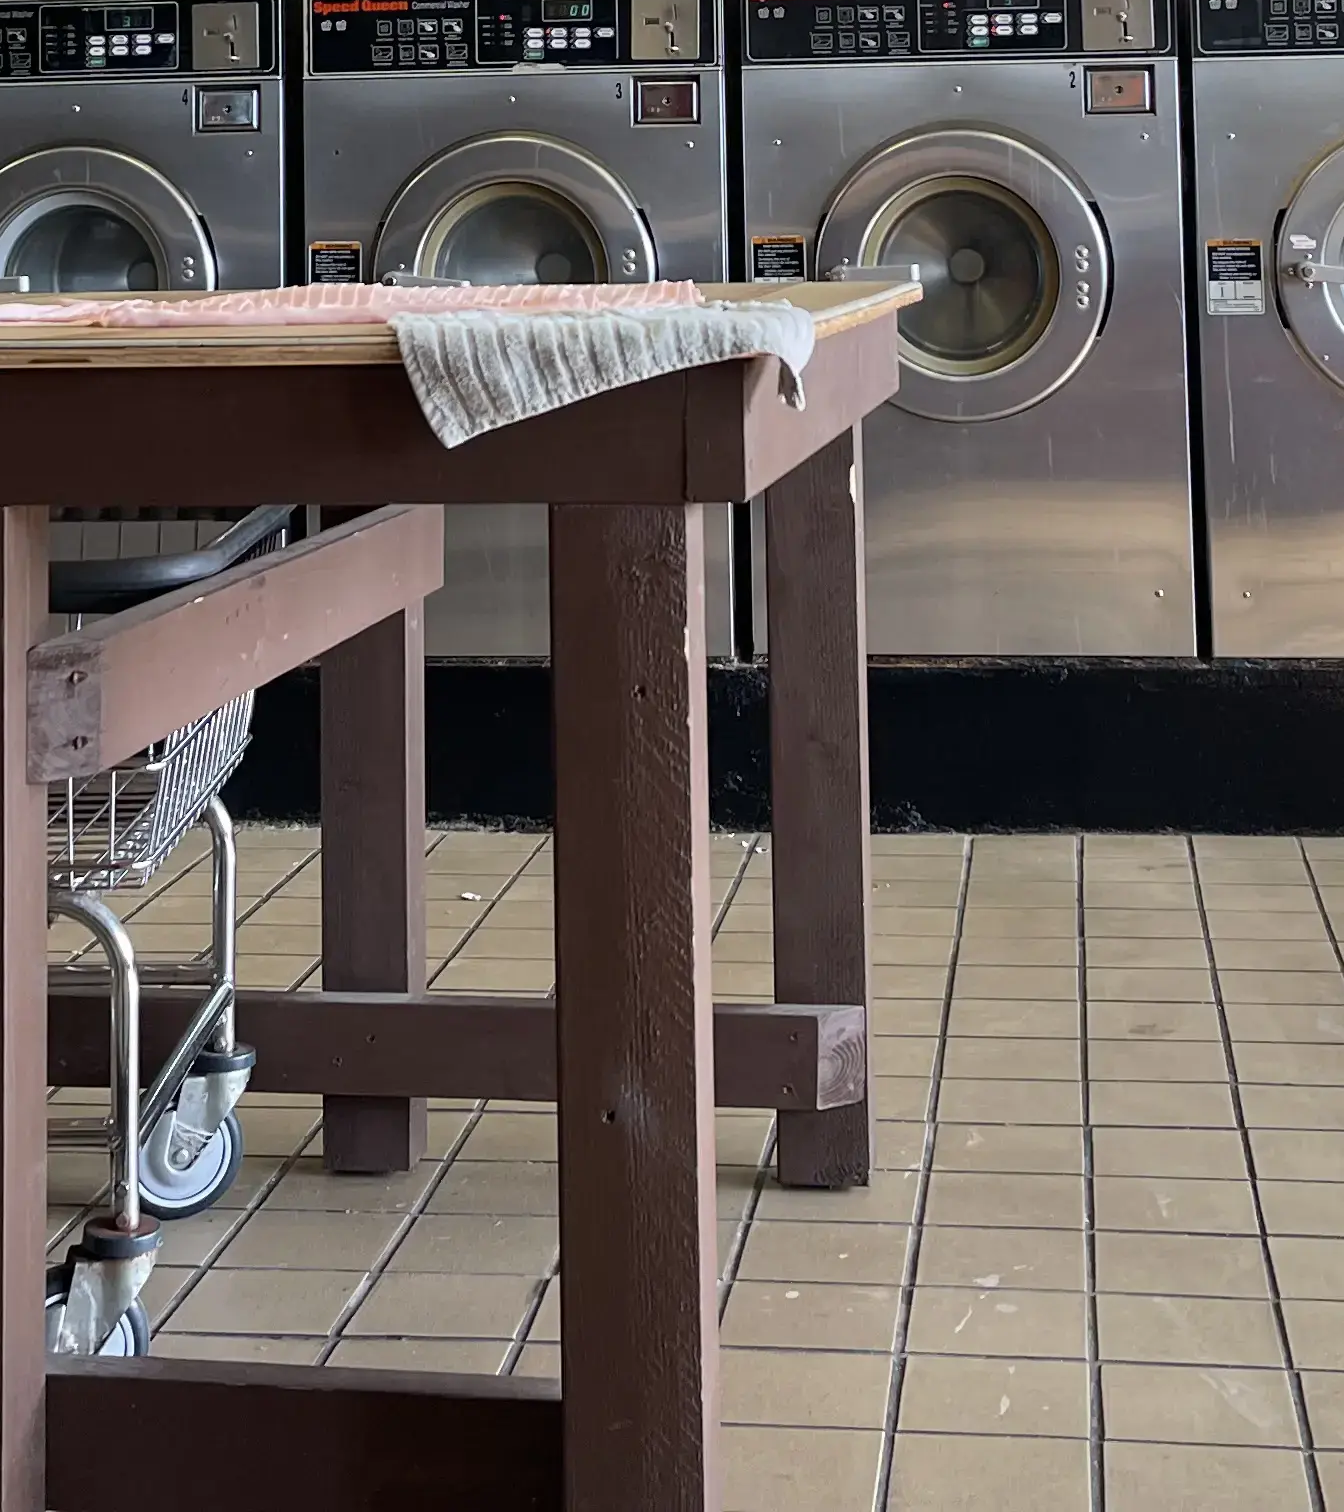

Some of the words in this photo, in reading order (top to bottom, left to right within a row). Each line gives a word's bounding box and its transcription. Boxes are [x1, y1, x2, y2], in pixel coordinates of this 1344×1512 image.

[313, 0, 359, 15] Speed
[362, 0, 408, 11] Queen
[1069, 71, 1076, 88] 2
[182, 89, 188, 105] 4
[615, 82, 622, 99] 3
